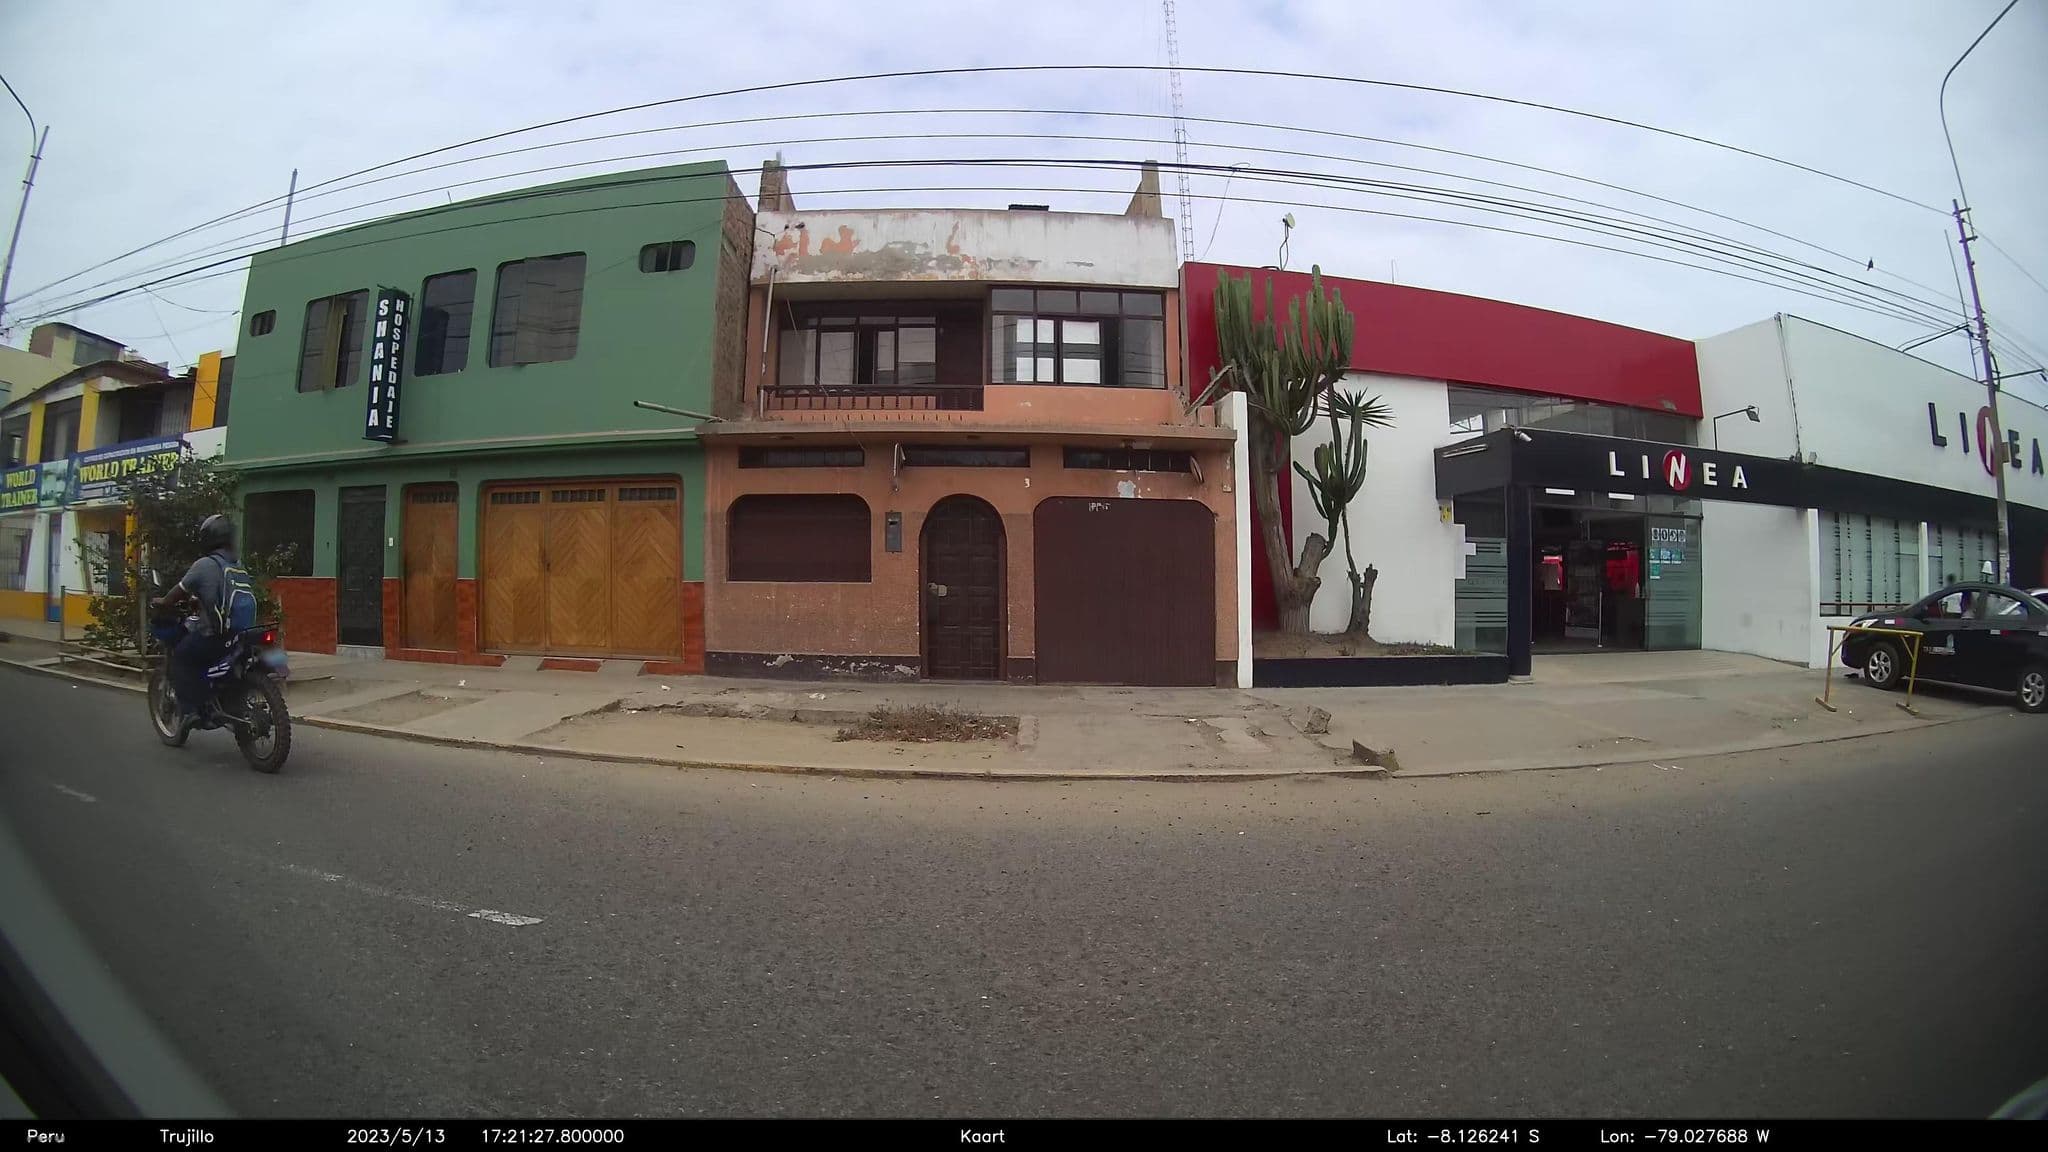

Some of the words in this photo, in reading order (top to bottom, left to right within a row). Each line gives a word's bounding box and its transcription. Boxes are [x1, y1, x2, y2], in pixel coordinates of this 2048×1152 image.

[368, 299, 389, 427] SHANIA
[386, 299, 405, 428] HOSPEDAJE
[6, 469, 36, 488] WORLD
[80, 460, 119, 484] WORLD
[1608, 450, 1748, 489] LINEA
[1, 488, 38, 508] TRAINER
